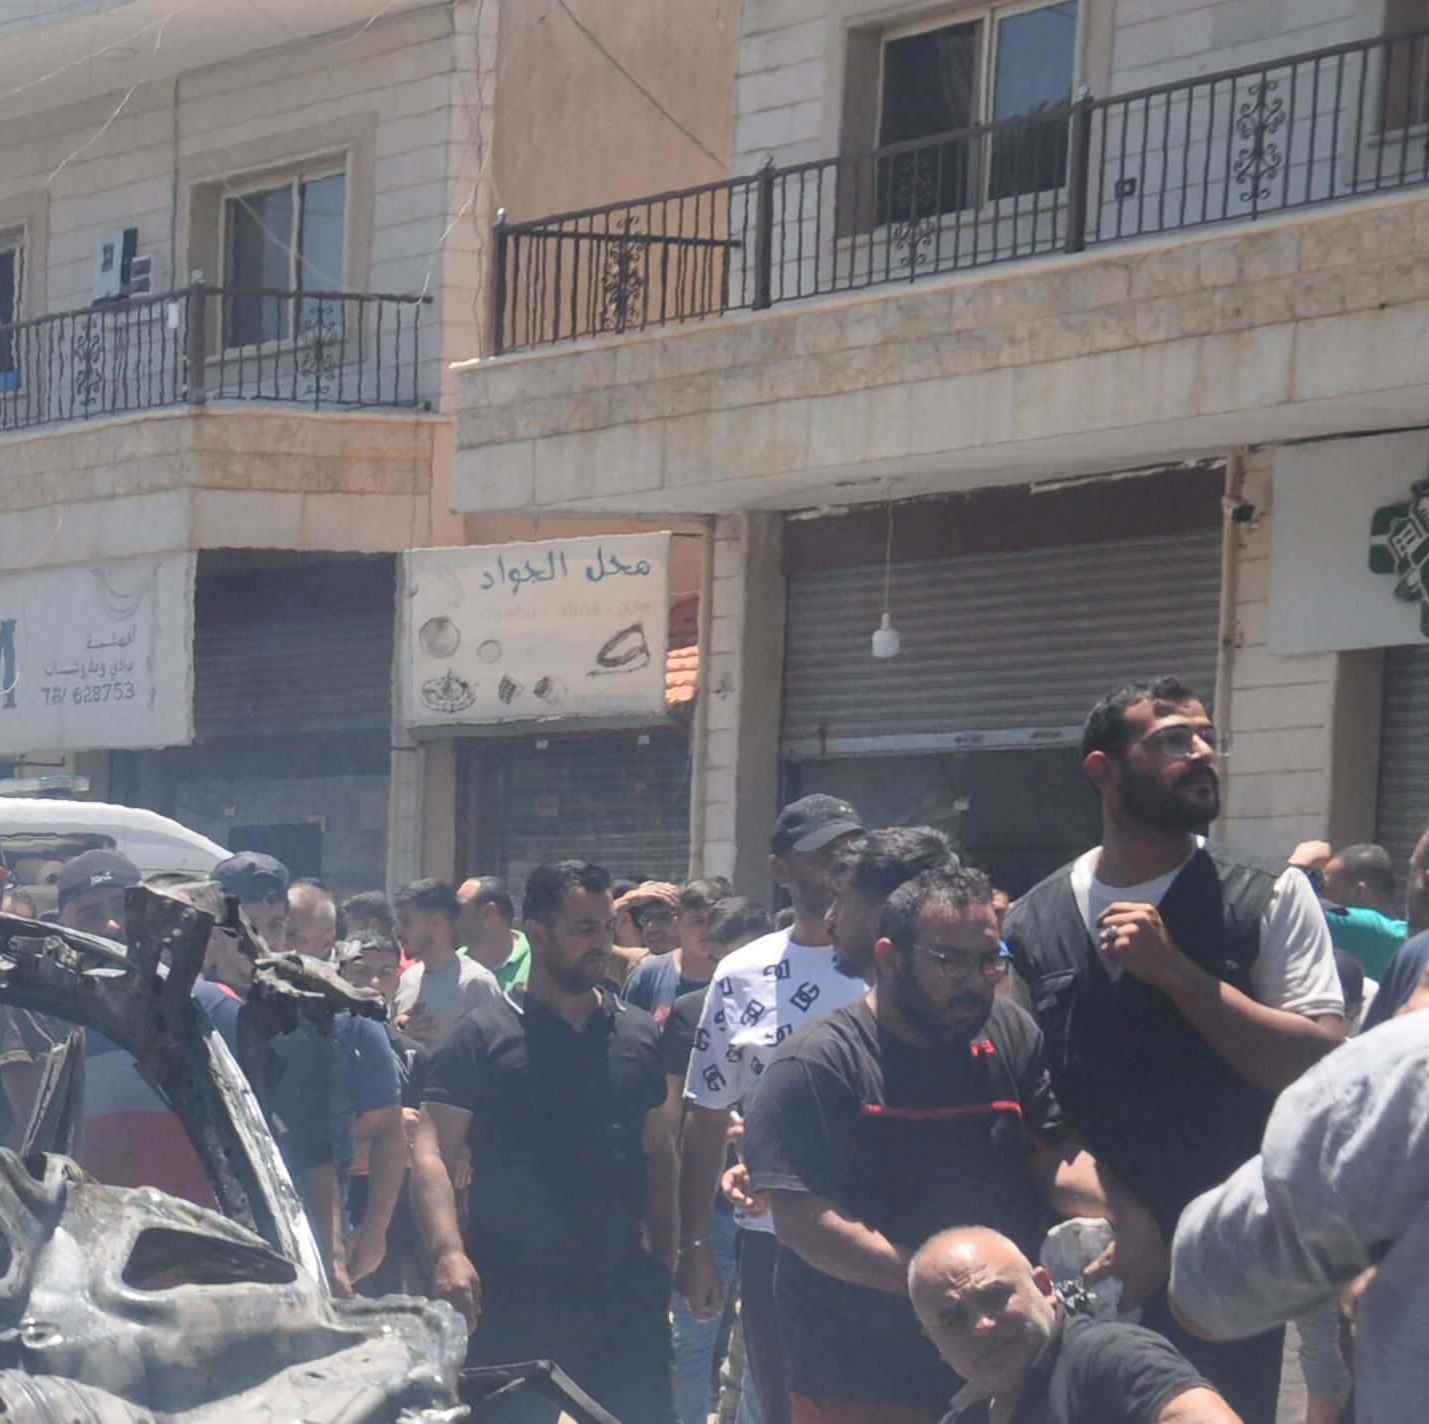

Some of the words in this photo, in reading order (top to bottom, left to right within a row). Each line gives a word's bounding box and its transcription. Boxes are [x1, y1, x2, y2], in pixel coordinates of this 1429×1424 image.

[479, 549, 568, 595] الجواد
[585, 548, 651, 583] محل
[72, 681, 135, 705] 628753
[789, 981, 821, 1013] DG
